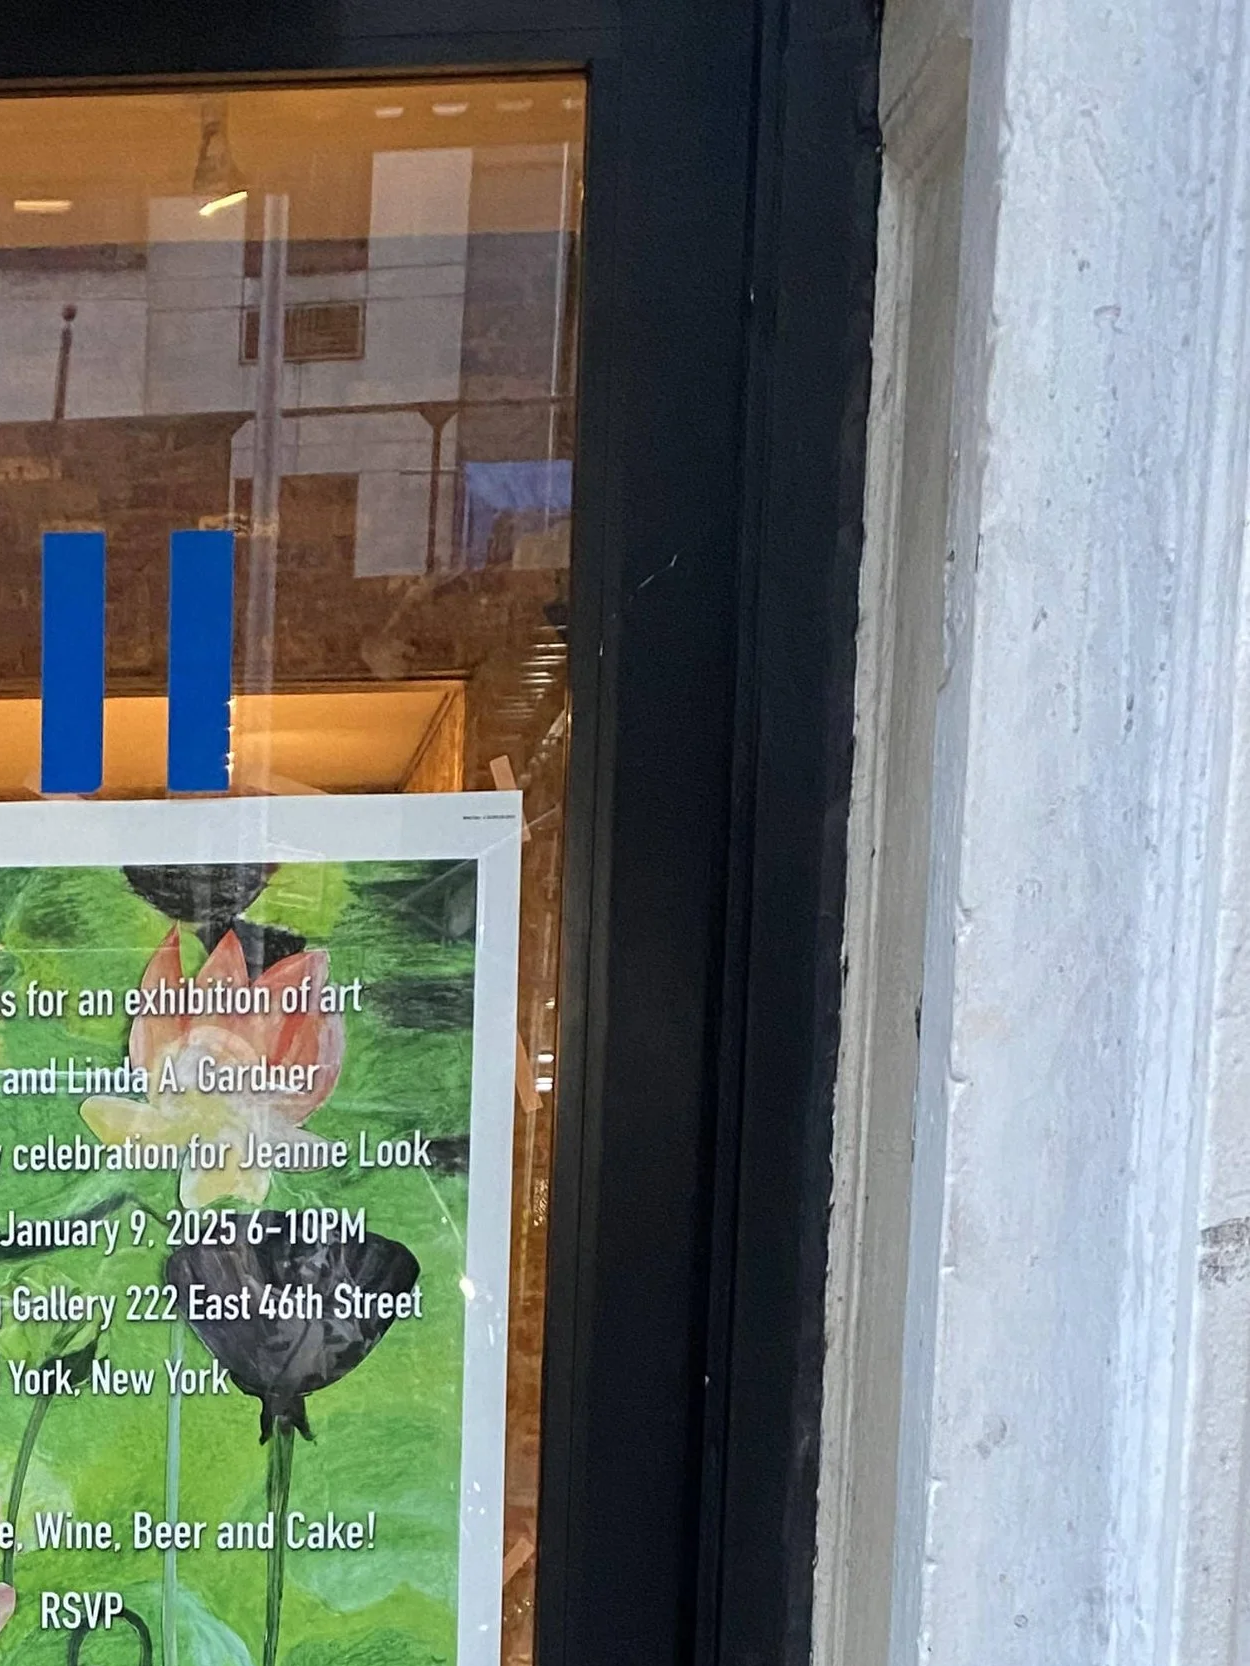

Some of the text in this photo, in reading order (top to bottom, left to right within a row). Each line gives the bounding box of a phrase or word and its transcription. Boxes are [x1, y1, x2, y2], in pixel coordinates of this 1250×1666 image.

[26, 980, 68, 1017] for
[78, 987, 113, 1016] an
[125, 977, 270, 1015] exhibition
[281, 976, 312, 1014] of
[320, 978, 363, 1013] art
[2, 1057, 56, 1094] and
[68, 1057, 147, 1094] Linda
[158, 1055, 185, 1093] A.
[198, 1054, 320, 1093] Gardner
[13, 1133, 177, 1171] celebration
[188, 1133, 231, 1169] for
[239, 1132, 347, 1169] Jeanne
[359, 1130, 432, 1167] Look
[0, 1210, 119, 1256] January
[130, 1210, 155, 1248] 9,
[166, 1209, 237, 1246] 2025
[247, 1208, 366, 1245] 6-10PM
[12, 1286, 116, 1330] Gallery
[126, 1285, 178, 1320] 222
[189, 1284, 251, 1320] East
[259, 1283, 323, 1319] 46th
[333, 1282, 423, 1319] Street
[7, 1359, 81, 1397] York,
[92, 1359, 156, 1395] New
[164, 1359, 231, 1395] York
[35, 1511, 121, 1552] Wine,
[133, 1511, 207, 1549] Beer
[216, 1511, 275, 1549] and
[287, 1511, 377, 1549] Cake!
[41, 1591, 124, 1629] RSVP
